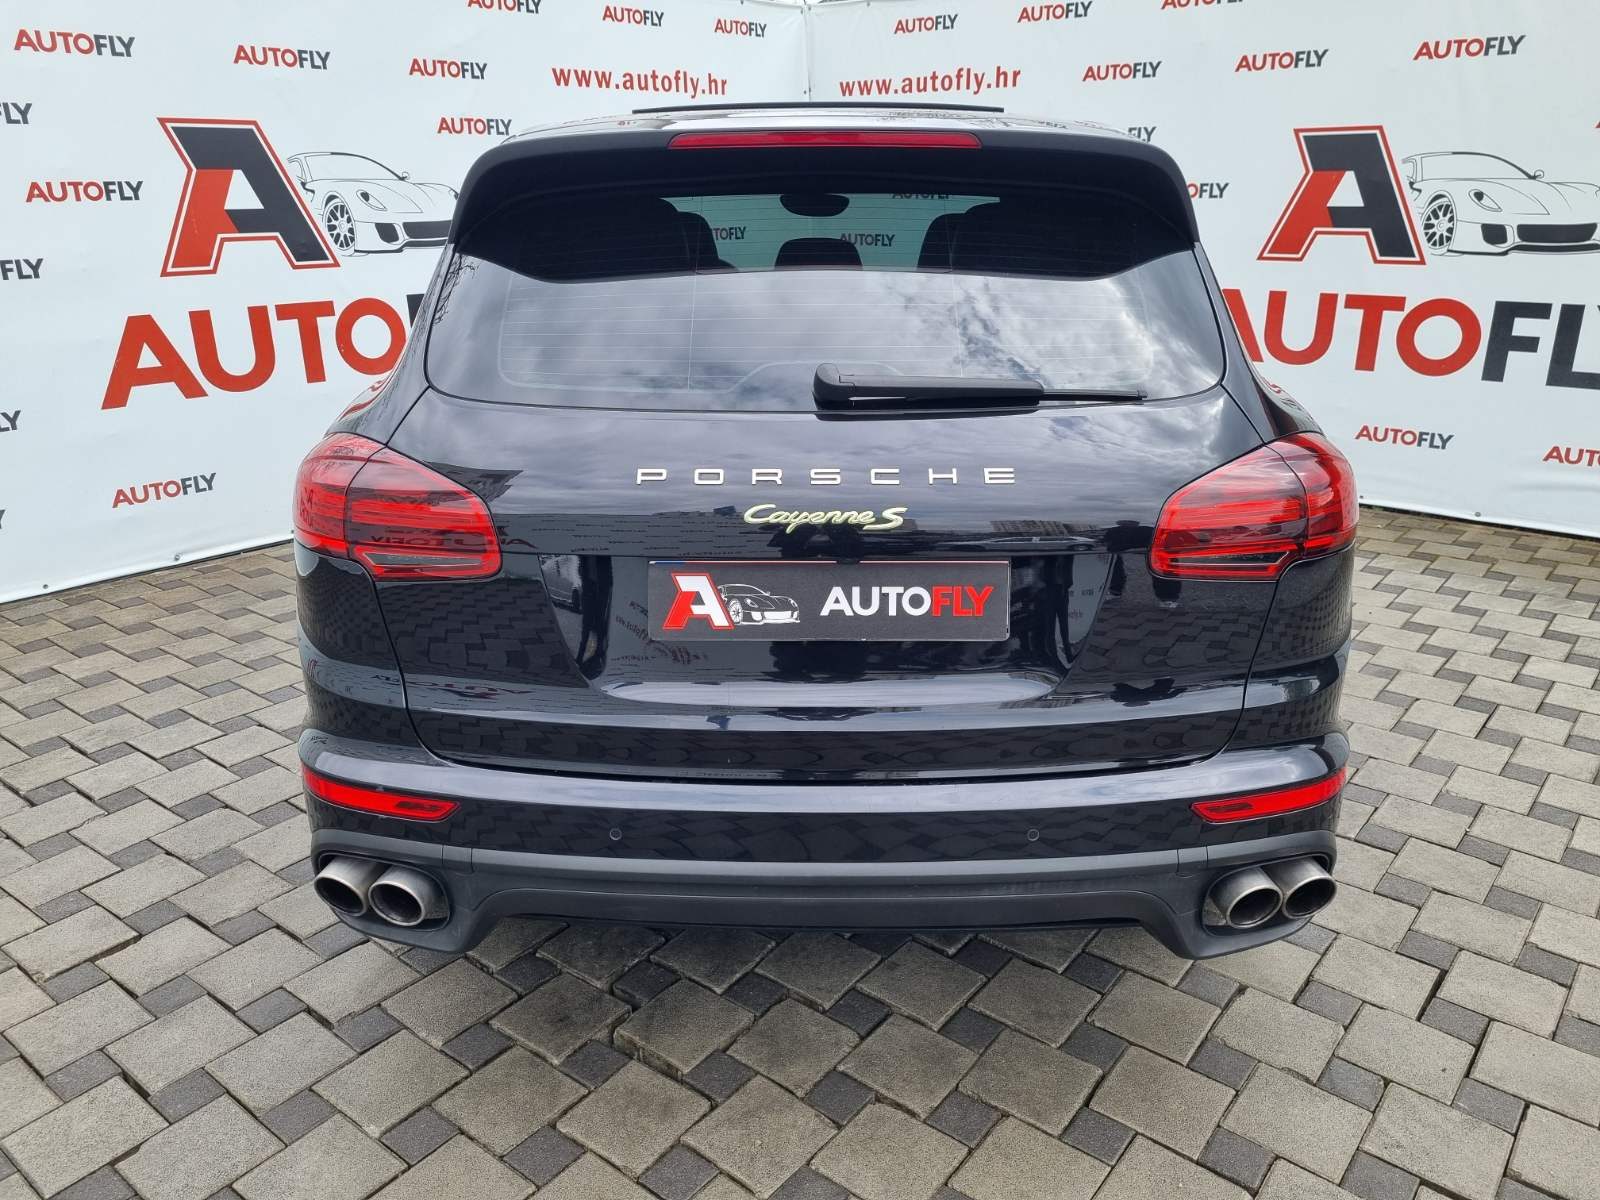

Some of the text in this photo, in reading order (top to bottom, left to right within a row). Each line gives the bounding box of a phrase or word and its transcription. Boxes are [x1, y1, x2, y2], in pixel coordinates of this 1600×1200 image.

[603, 6, 664, 27] AUTOFLY
[1018, 1, 1093, 23] AUTOFLY
[714, 19, 766, 37] AUTOFLY
[894, 14, 958, 34] AUTOFLY
[14, 29, 135, 57] AUTOFLY
[1413, 35, 1525, 60] AUTOFLY
[234, 45, 330, 70] AUTOFLY
[409, 58, 487, 79] AUTOFLY
[1235, 49, 1328, 72] AUTOFLY
[840, 66, 1021, 96] www.autofly.hr
[1082, 61, 1161, 81] AUTOFLY
[552, 68, 727, 98] www.autofly.hr
[0, 102, 32, 124] LY
[437, 117, 512, 136] AUTOFLY
[26, 181, 143, 202] AUTOFLY
[0, 258, 43, 280] FLY
[1221, 288, 1600, 391] UTOFL
[101, 294, 424, 410] AUTO
[1355, 425, 1454, 449] AUTOFLY
[1543, 446, 1600, 467] AUT
[636, 467, 1017, 486] PORSCHE
[112, 473, 216, 508] AUTOFLY
[743, 503, 909, 534] Cayenne S
[820, 586, 995, 617] AUTOFLY
